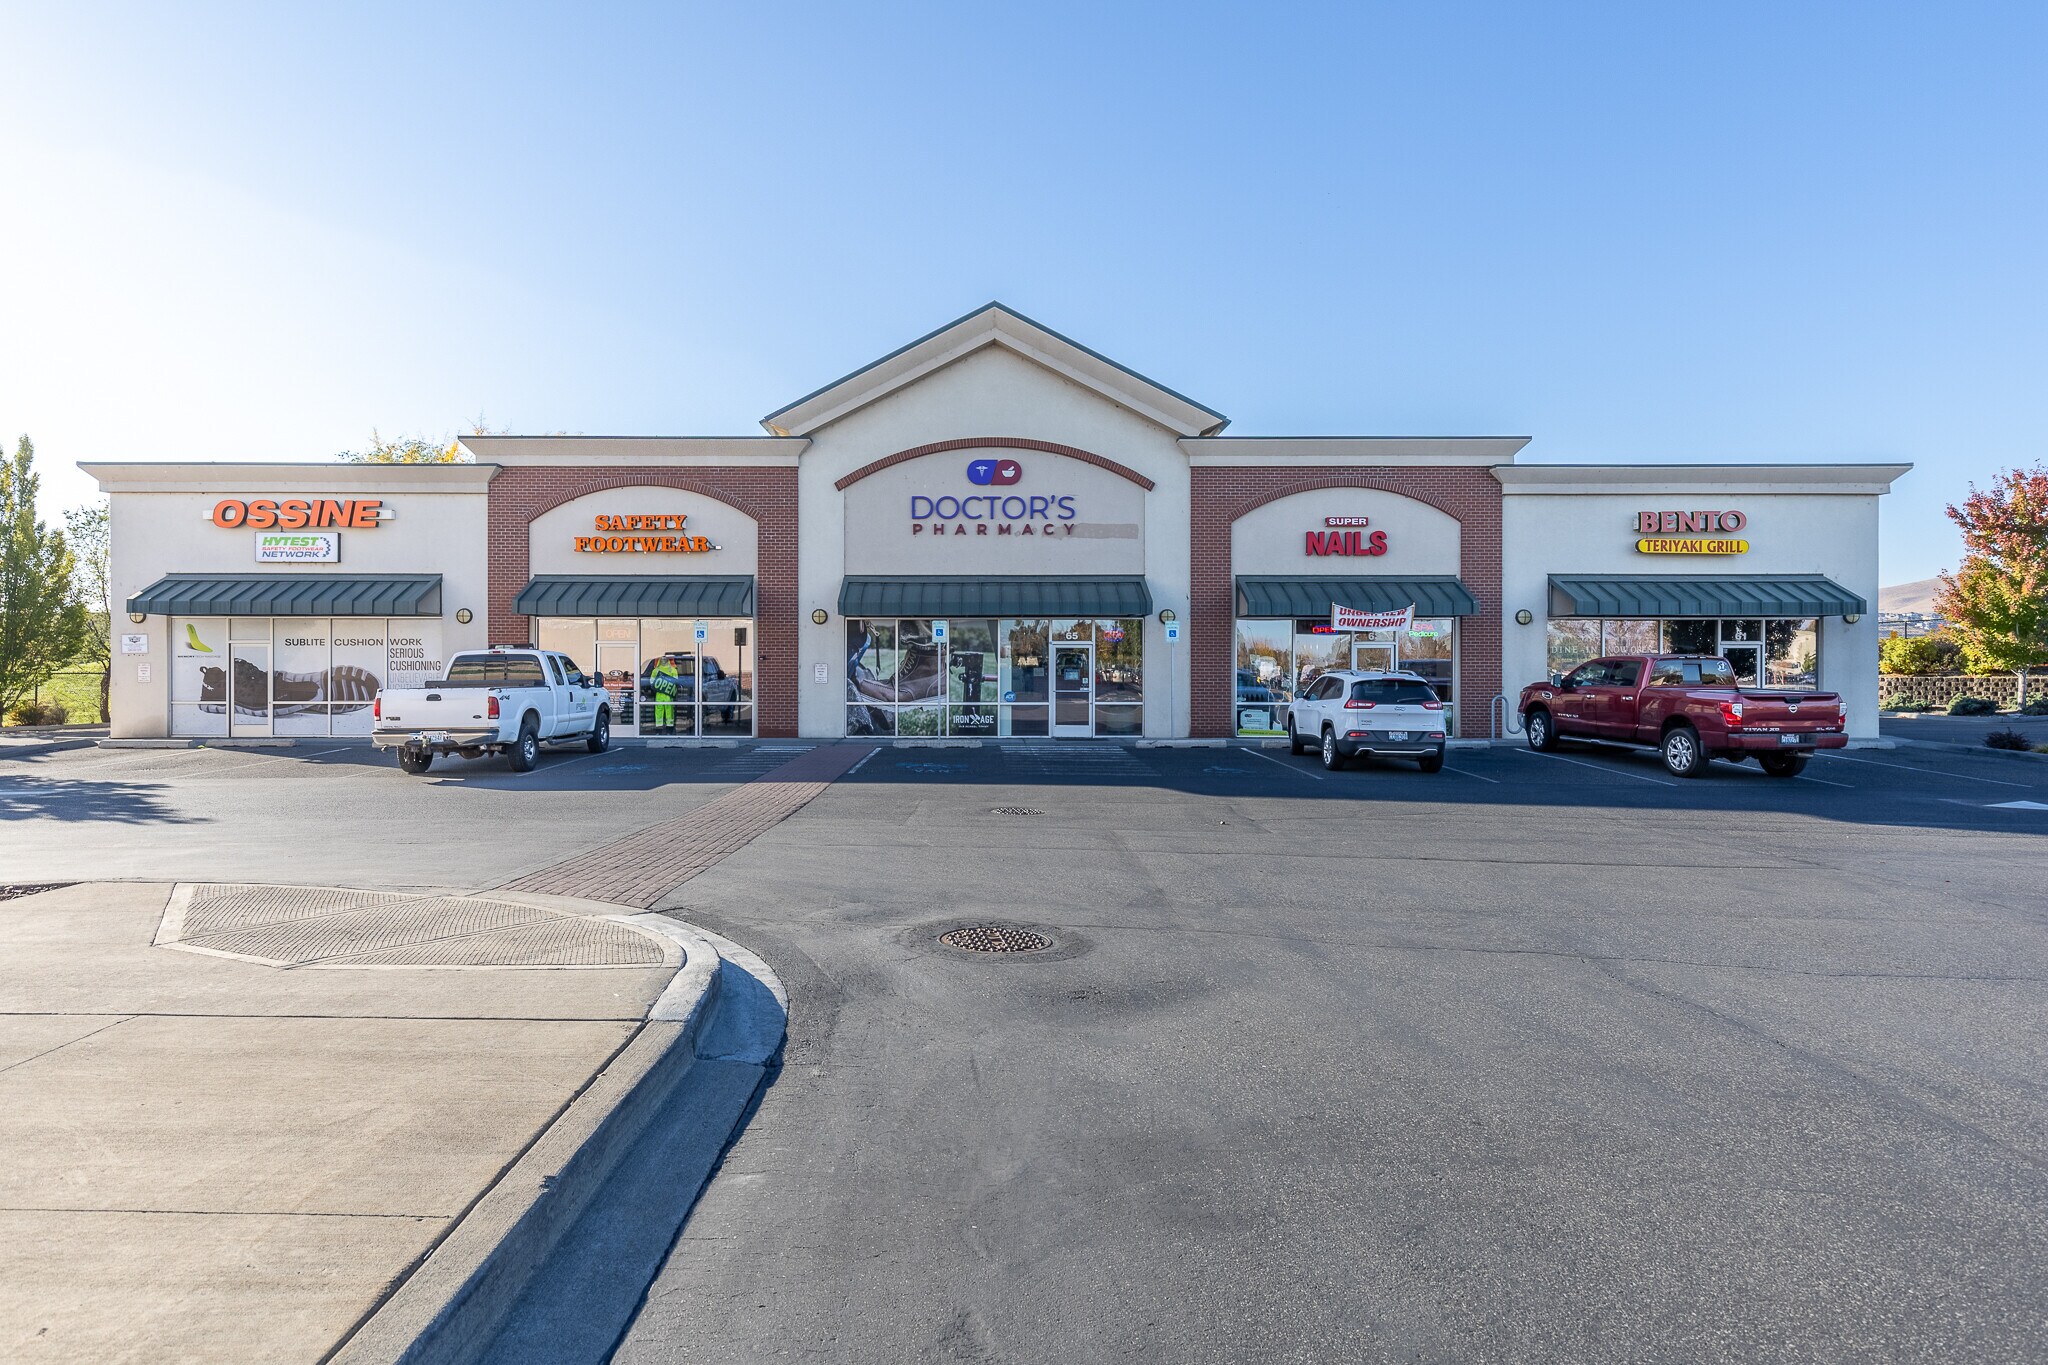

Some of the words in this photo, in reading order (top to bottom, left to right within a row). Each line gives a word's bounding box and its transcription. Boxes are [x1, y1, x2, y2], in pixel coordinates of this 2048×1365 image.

[911, 494, 1076, 520] DOCTOR'S
[213, 499, 382, 529] OSSINE
[595, 514, 687, 531] SAFETY
[1328, 517, 1367, 525] SUPER
[1638, 510, 1747, 533] BENTO
[912, 523, 1075, 535] PHARMACY
[262, 536, 319, 547] HYTEST
[574, 536, 710, 552] FOOTWEAR
[1305, 530, 1388, 557] NAILS
[1645, 539, 1702, 552] TERIYAKI
[1707, 540, 1743, 553] GRILL
[1338, 617, 1407, 628] OWNERSHIP
[1413, 623, 1435, 632] SPA
[605, 628, 631, 639] OPEN
[1065, 632, 1079, 640] 65
[284, 638, 326, 647] SUBLITE
[333, 638, 384, 647] CUSHION
[389, 638, 423, 646] WORK
[389, 647, 425, 659] SERIOUS
[389, 660, 442, 672] CUSHIONING
[654, 677, 678, 697] OPEN
[953, 715, 970, 724] IRON
[980, 715, 995, 724] AGE
